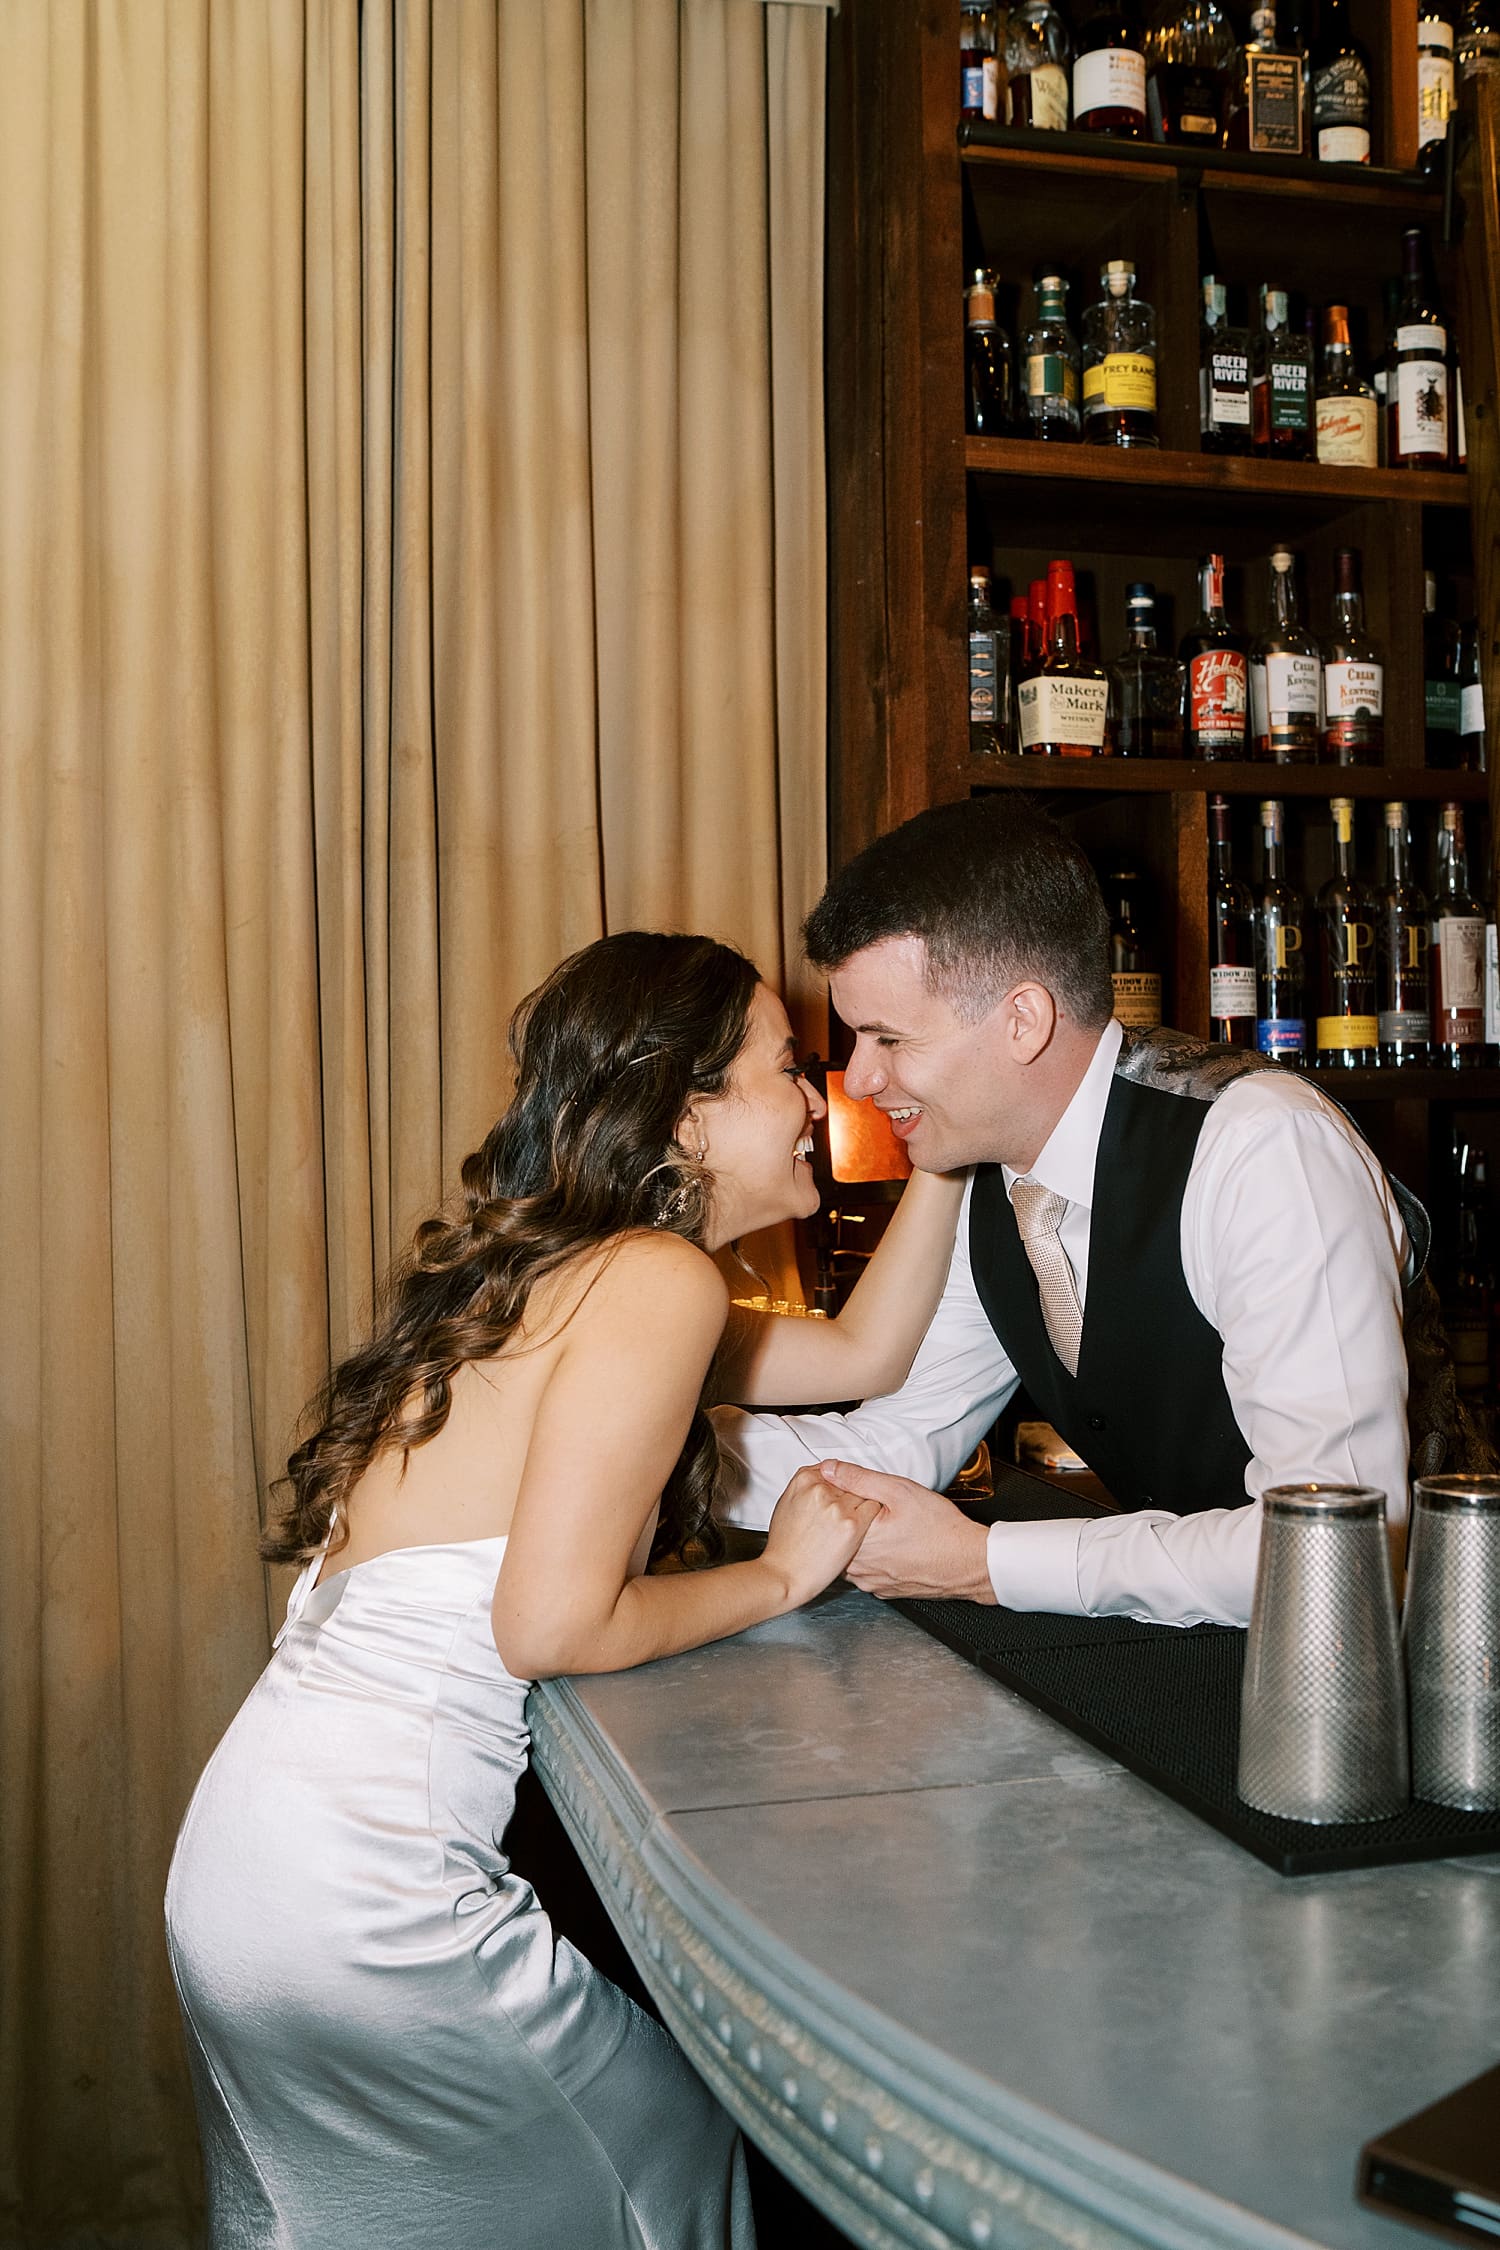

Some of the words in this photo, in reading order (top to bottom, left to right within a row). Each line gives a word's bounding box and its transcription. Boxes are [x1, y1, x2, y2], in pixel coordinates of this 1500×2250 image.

[1212, 354, 1247, 369] GREEN
[1103, 364, 1129, 375] FREY
[1214, 367, 1247, 382] RIVER
[1271, 364, 1307, 378] GREEN
[1273, 376, 1306, 392] RIVER
[1050, 683, 1105, 698] Maker's
[1066, 697, 1104, 711] Mark
[1276, 925, 1302, 968] P
[1342, 922, 1374, 966] P
[1403, 925, 1429, 968] P
